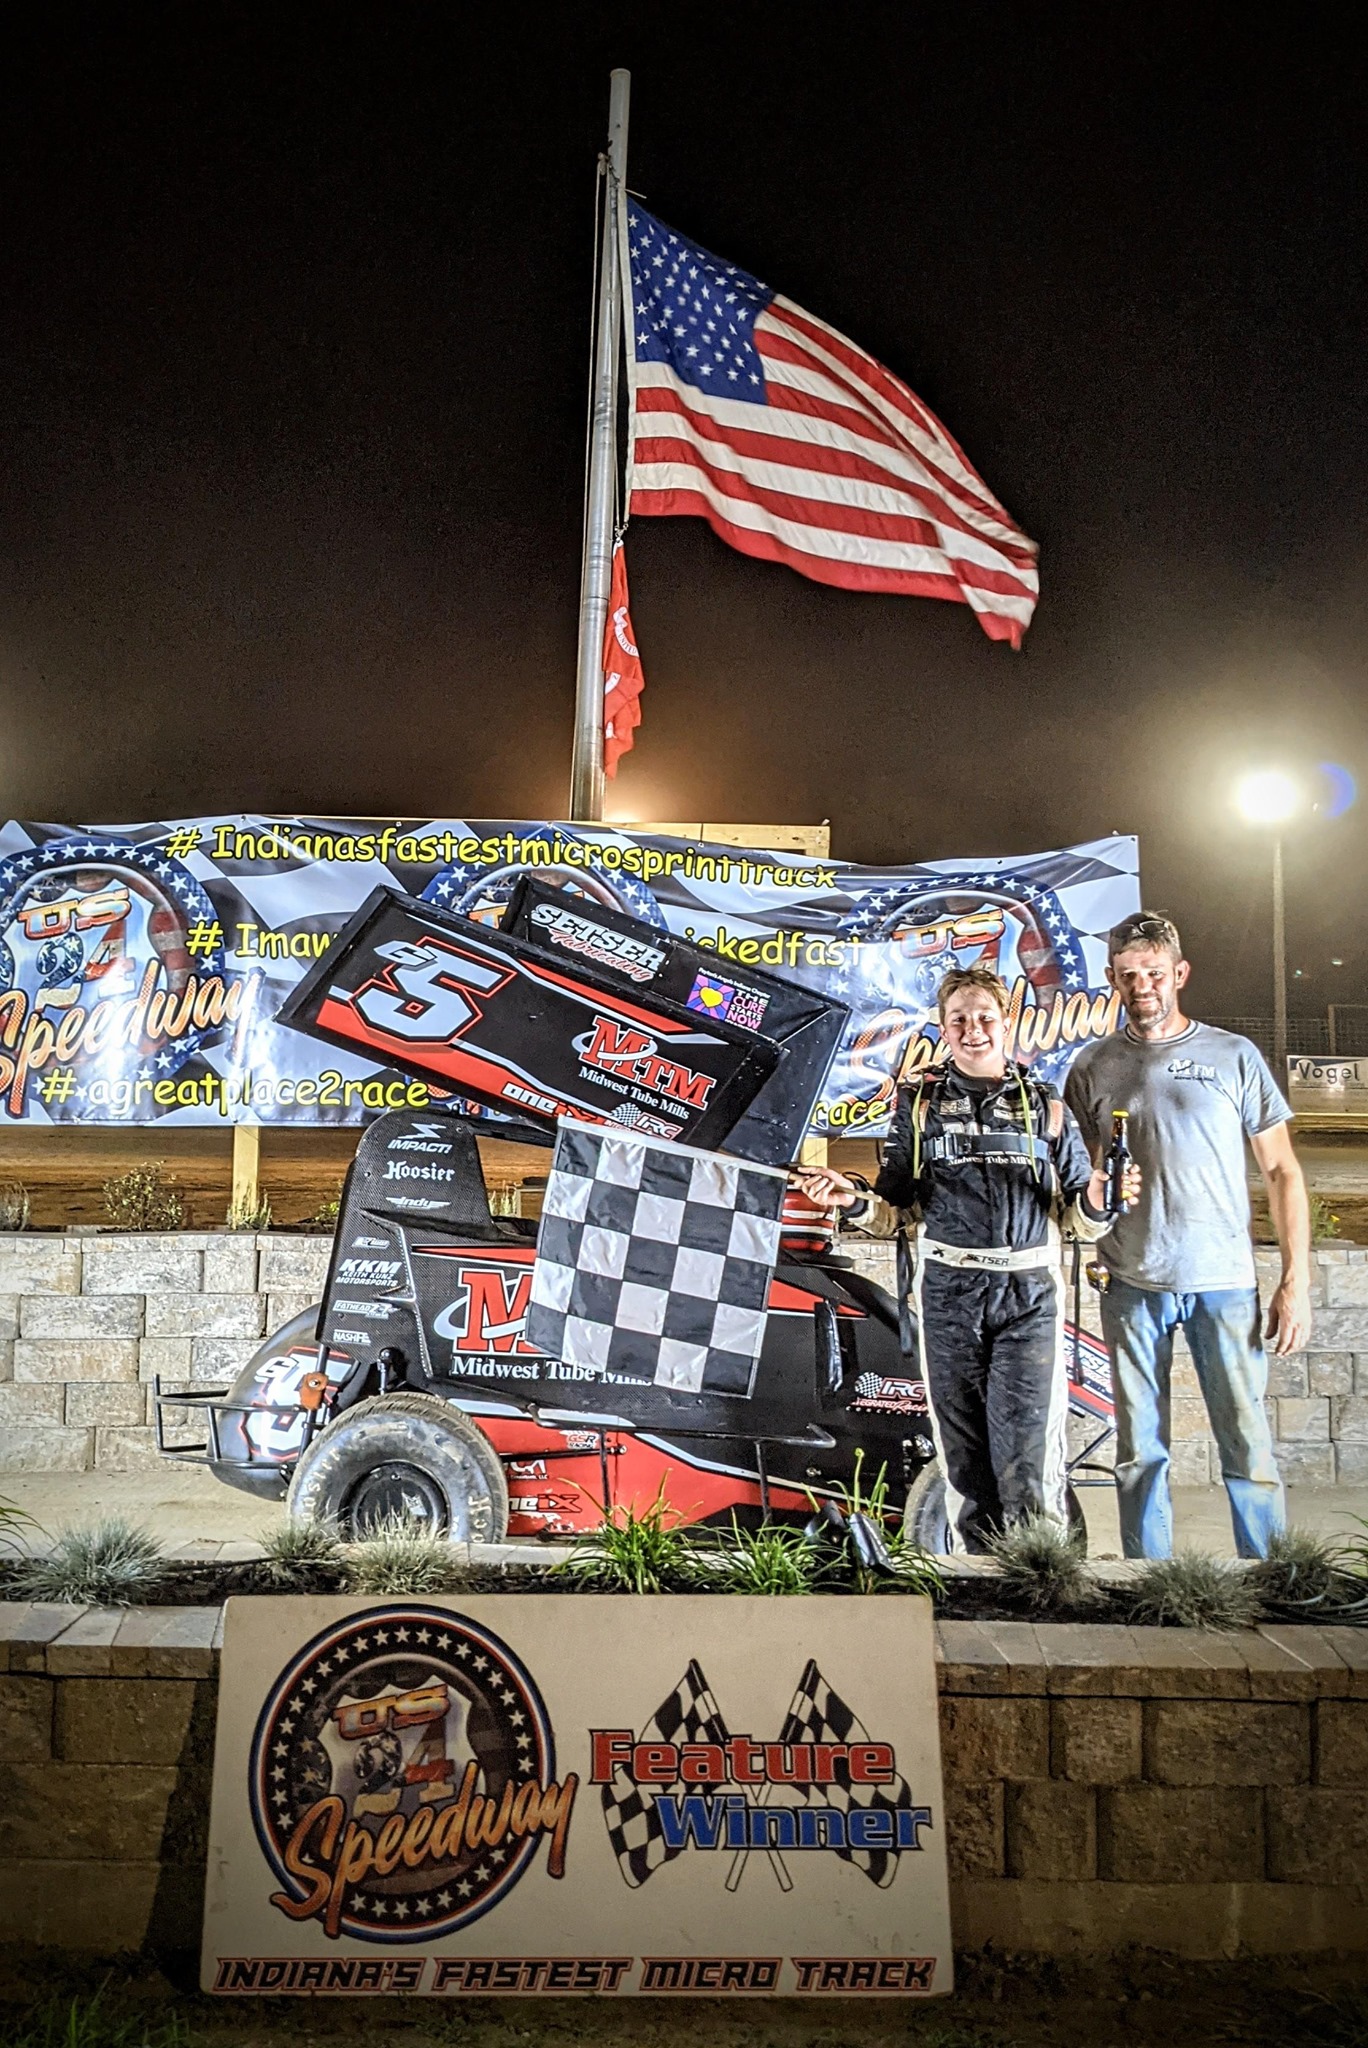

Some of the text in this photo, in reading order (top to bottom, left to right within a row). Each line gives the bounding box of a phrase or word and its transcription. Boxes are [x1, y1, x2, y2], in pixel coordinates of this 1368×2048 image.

[165, 827, 836, 888] # Indianasfastestmicrosprinttrack
[17, 888, 131, 940] US
[186, 921, 224, 956] #
[685, 926, 864, 968] kedfast
[531, 903, 666, 971] SETSER
[892, 909, 1004, 958] US
[730, 1004, 762, 1020] STARTS
[733, 996, 766, 1015] CURE
[736, 989, 769, 1008] THE
[727, 1011, 761, 1029] NOW
[299, 1062, 360, 1085] Vogel
[578, 1015, 717, 1110] MTM
[42, 1068, 430, 1115] # agreatplace2race
[579, 1066, 690, 1119] Midwest Tube Mills
[634, 1113, 681, 1139] IRC
[387, 1139, 453, 1153] IMPACT!
[382, 1160, 455, 1181] Hoosier
[339, 1259, 402, 1273] KKM
[966, 1253, 1010, 1266] SETSER
[335, 1277, 398, 1287] MOTORSPORTS
[451, 1356, 539, 1379] Midwest
[545, 1360, 595, 1381] Tube
[879, 1378, 927, 1400] IRC
[568, 1434, 597, 1443] GSR
[333, 1684, 450, 1740] US
[353, 1720, 455, 1817] 24
[588, 1729, 895, 1785] Feature
[650, 1793, 933, 1851] Winner
[270, 1760, 579, 1939] Speedway
[214, 1958, 936, 1991] INDIANA'S FASTEST MICRO TRACK
